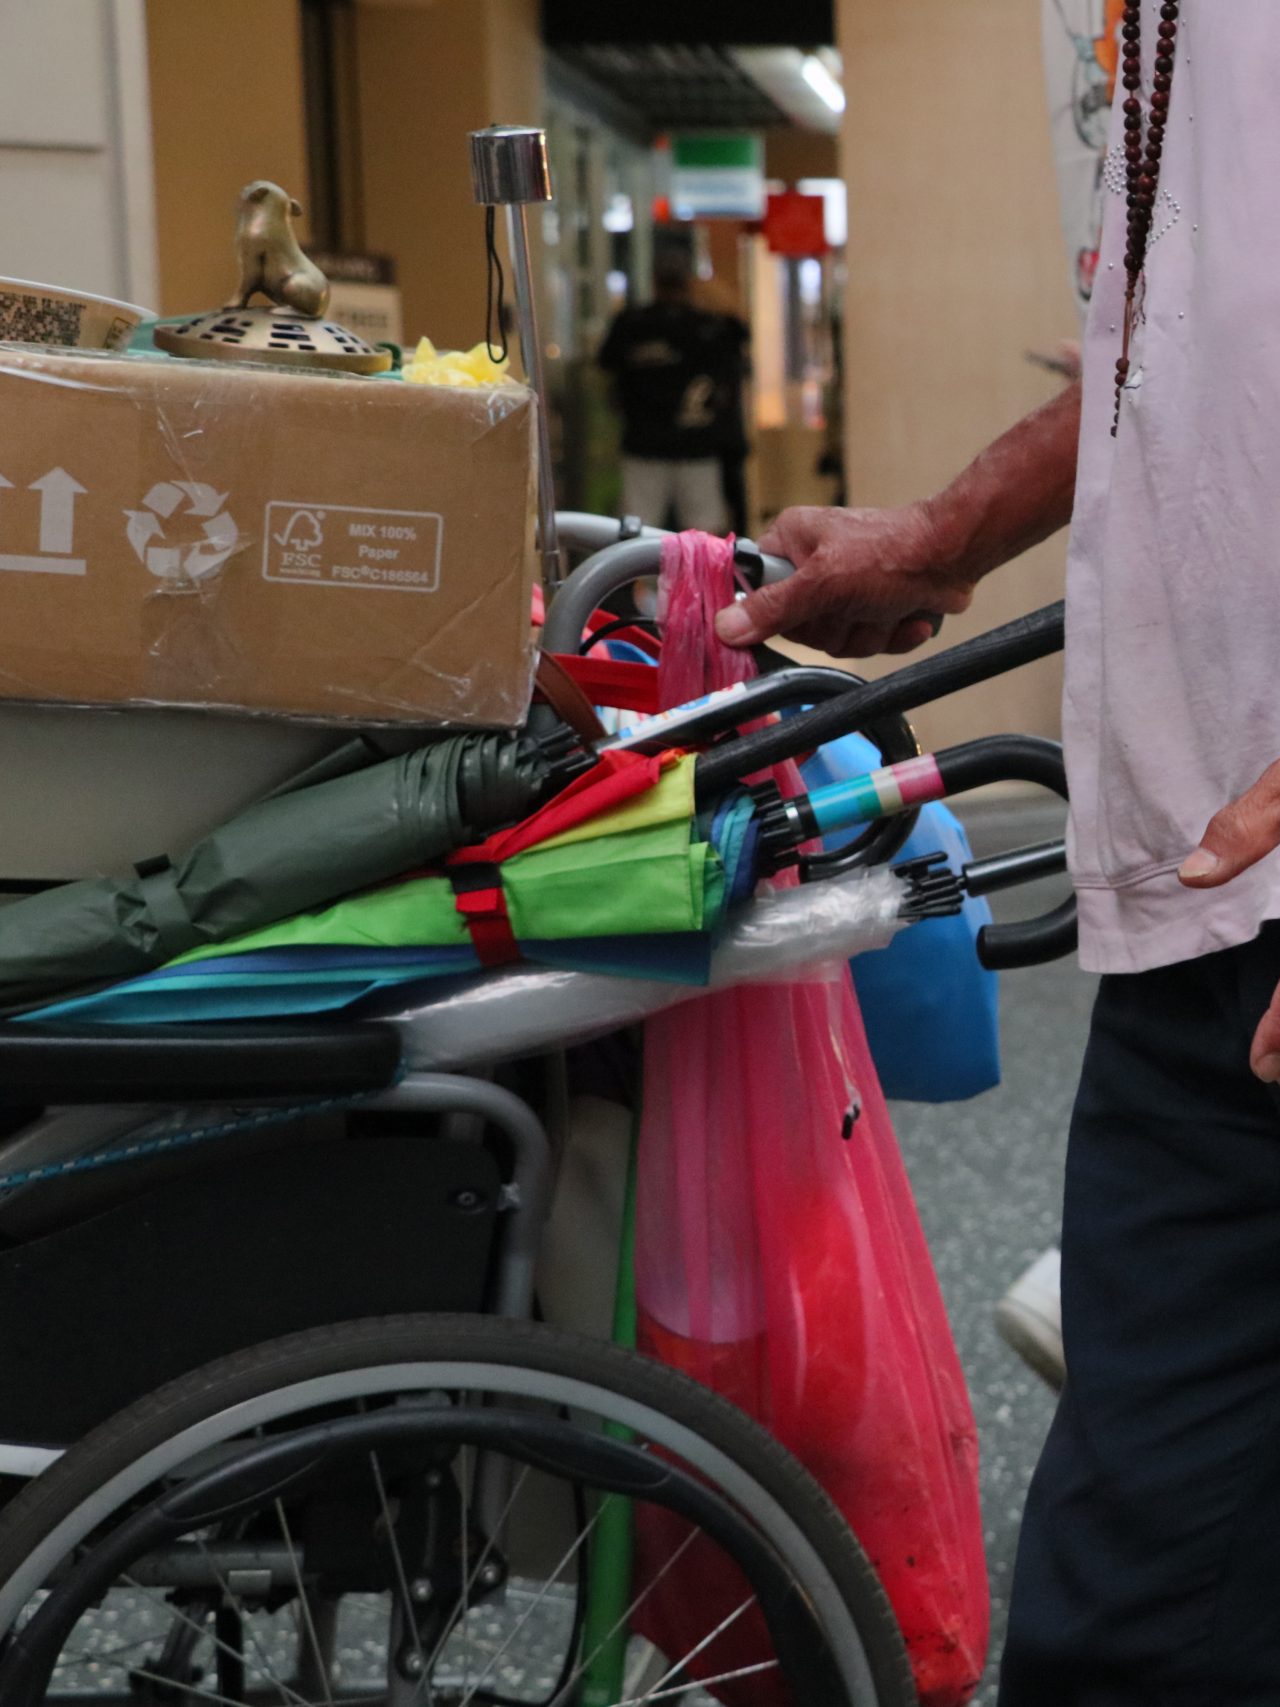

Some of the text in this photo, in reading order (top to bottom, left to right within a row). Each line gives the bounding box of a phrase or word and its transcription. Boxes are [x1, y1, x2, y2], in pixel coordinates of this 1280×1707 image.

[349, 523, 416, 541] MIX 100%
[281, 552, 321, 568] FSC
[359, 543, 400, 560] Paper
